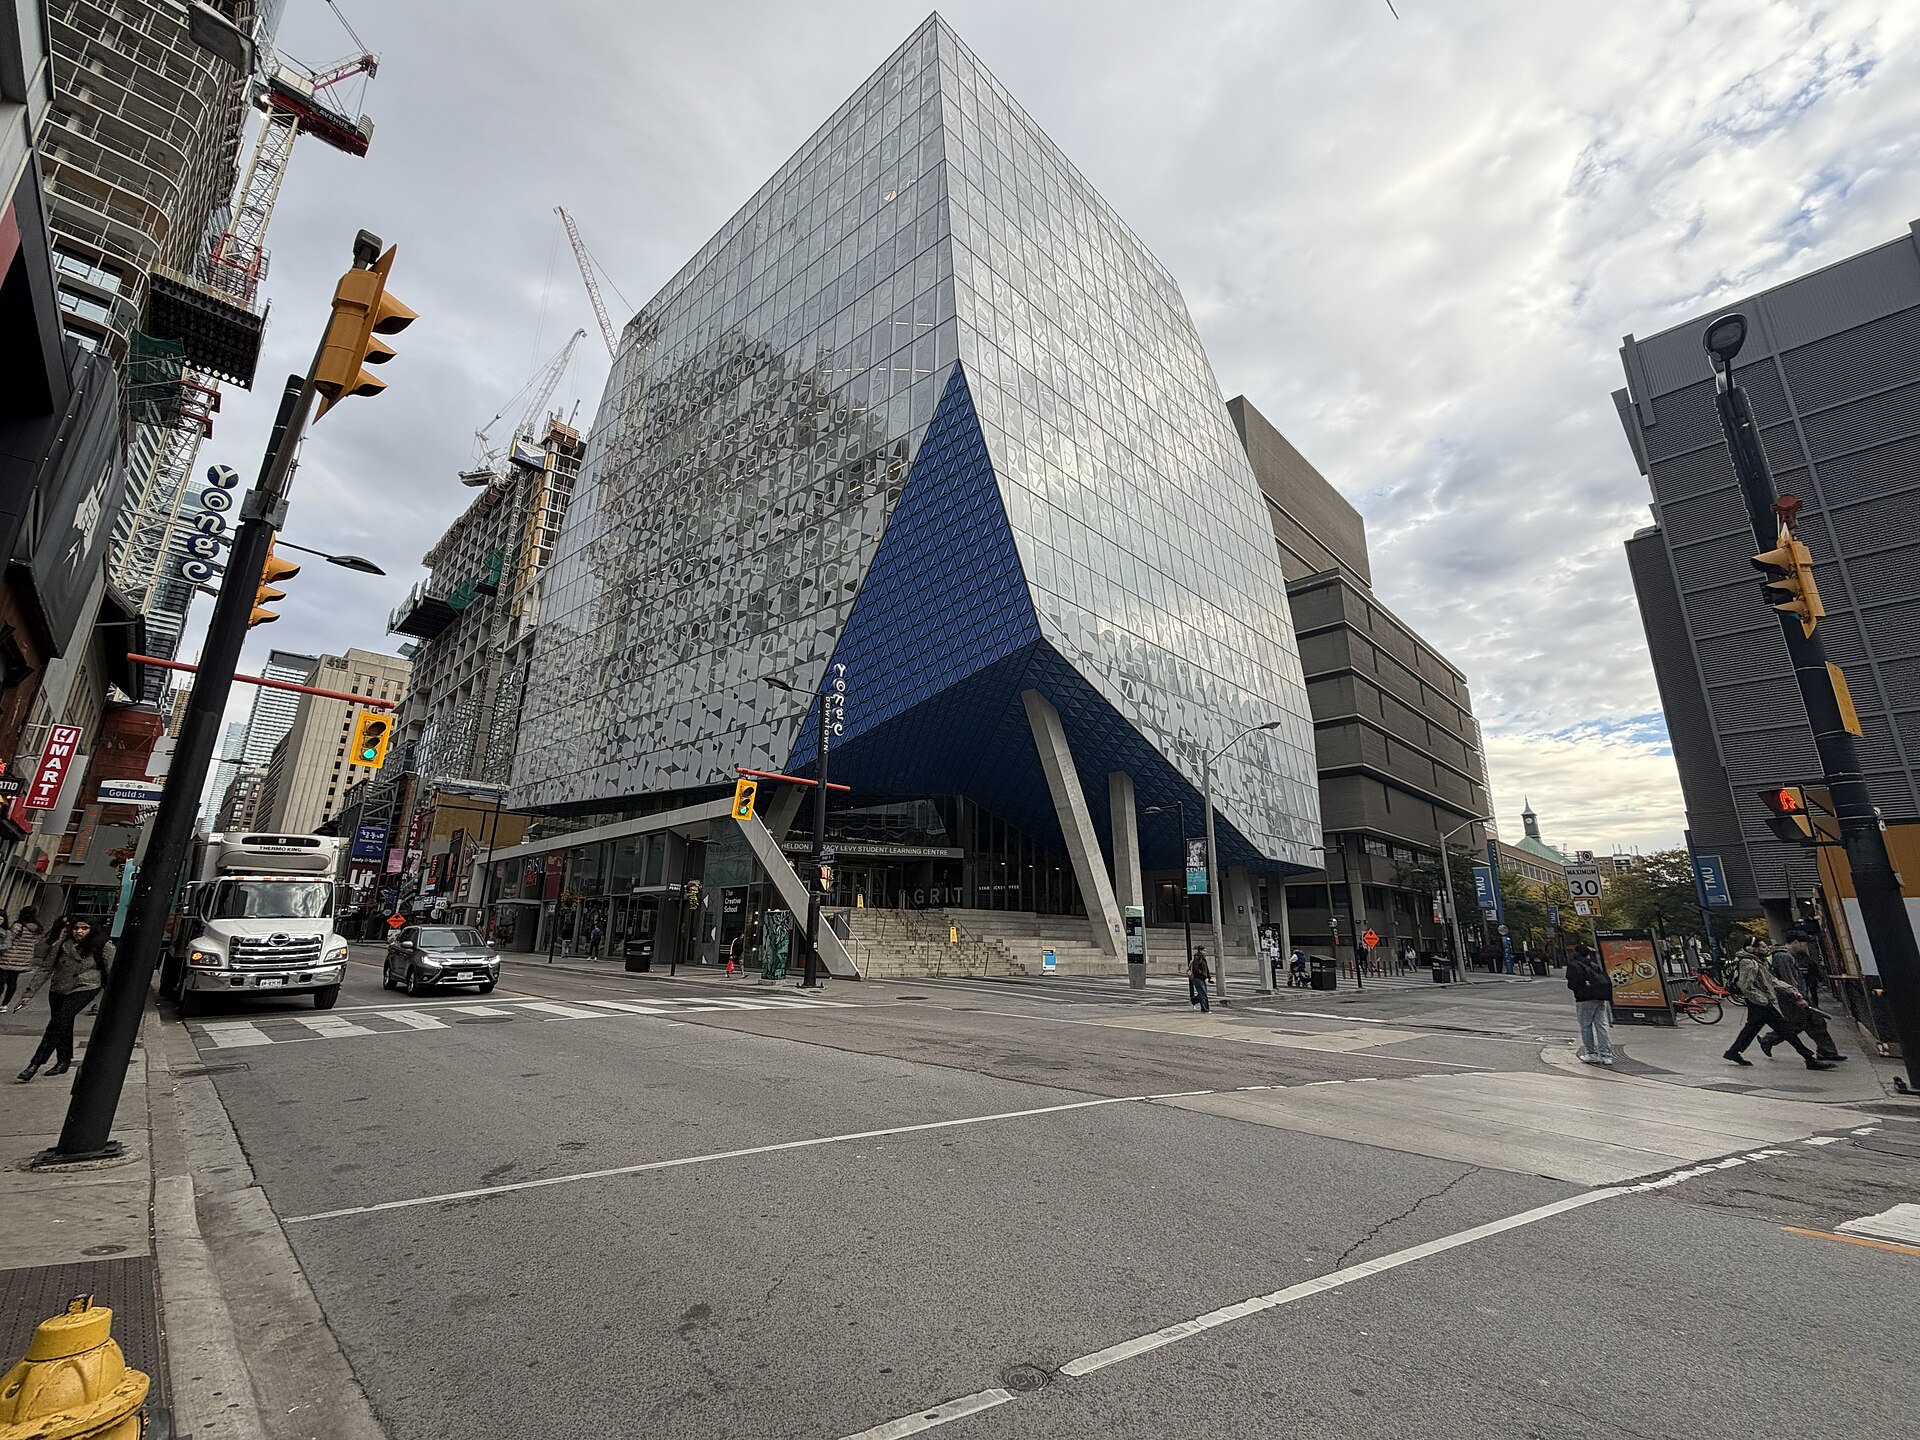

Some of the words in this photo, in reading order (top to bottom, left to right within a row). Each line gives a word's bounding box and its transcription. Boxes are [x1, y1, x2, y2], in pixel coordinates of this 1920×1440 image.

[182, 464, 238, 583] Yonge
[326, 656, 348, 669] 415
[832, 663, 846, 736] Yonge
[39, 744, 70, 796] MART
[109, 789, 136, 798] Gould
[781, 842, 807, 850] HELDON
[889, 847, 922, 855] LEARNING
[1475, 876, 1487, 897] TMU
[1571, 880, 1598, 895] 30
[1701, 867, 1717, 891] TMU
[914, 886, 963, 904] GRIT
[723, 905, 738, 913] School
